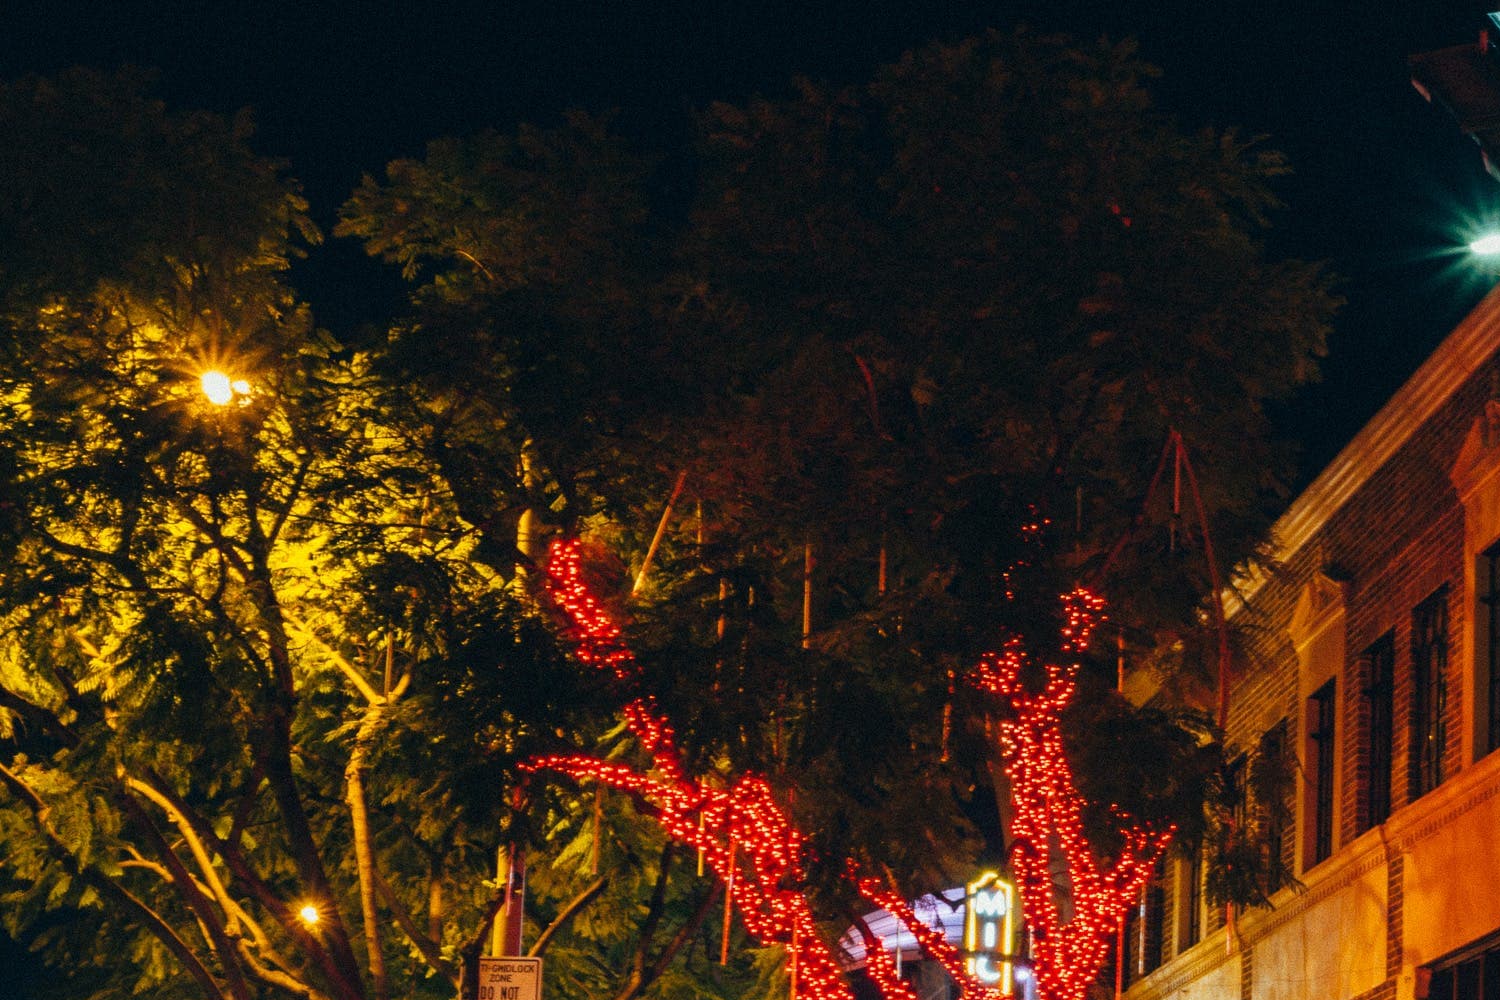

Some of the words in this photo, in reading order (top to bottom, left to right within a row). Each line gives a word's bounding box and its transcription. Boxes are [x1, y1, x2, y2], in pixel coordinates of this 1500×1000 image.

[488, 974, 513, 983] ZONE
[480, 986, 495, 1000] DO
[501, 986, 520, 1000] NOT
